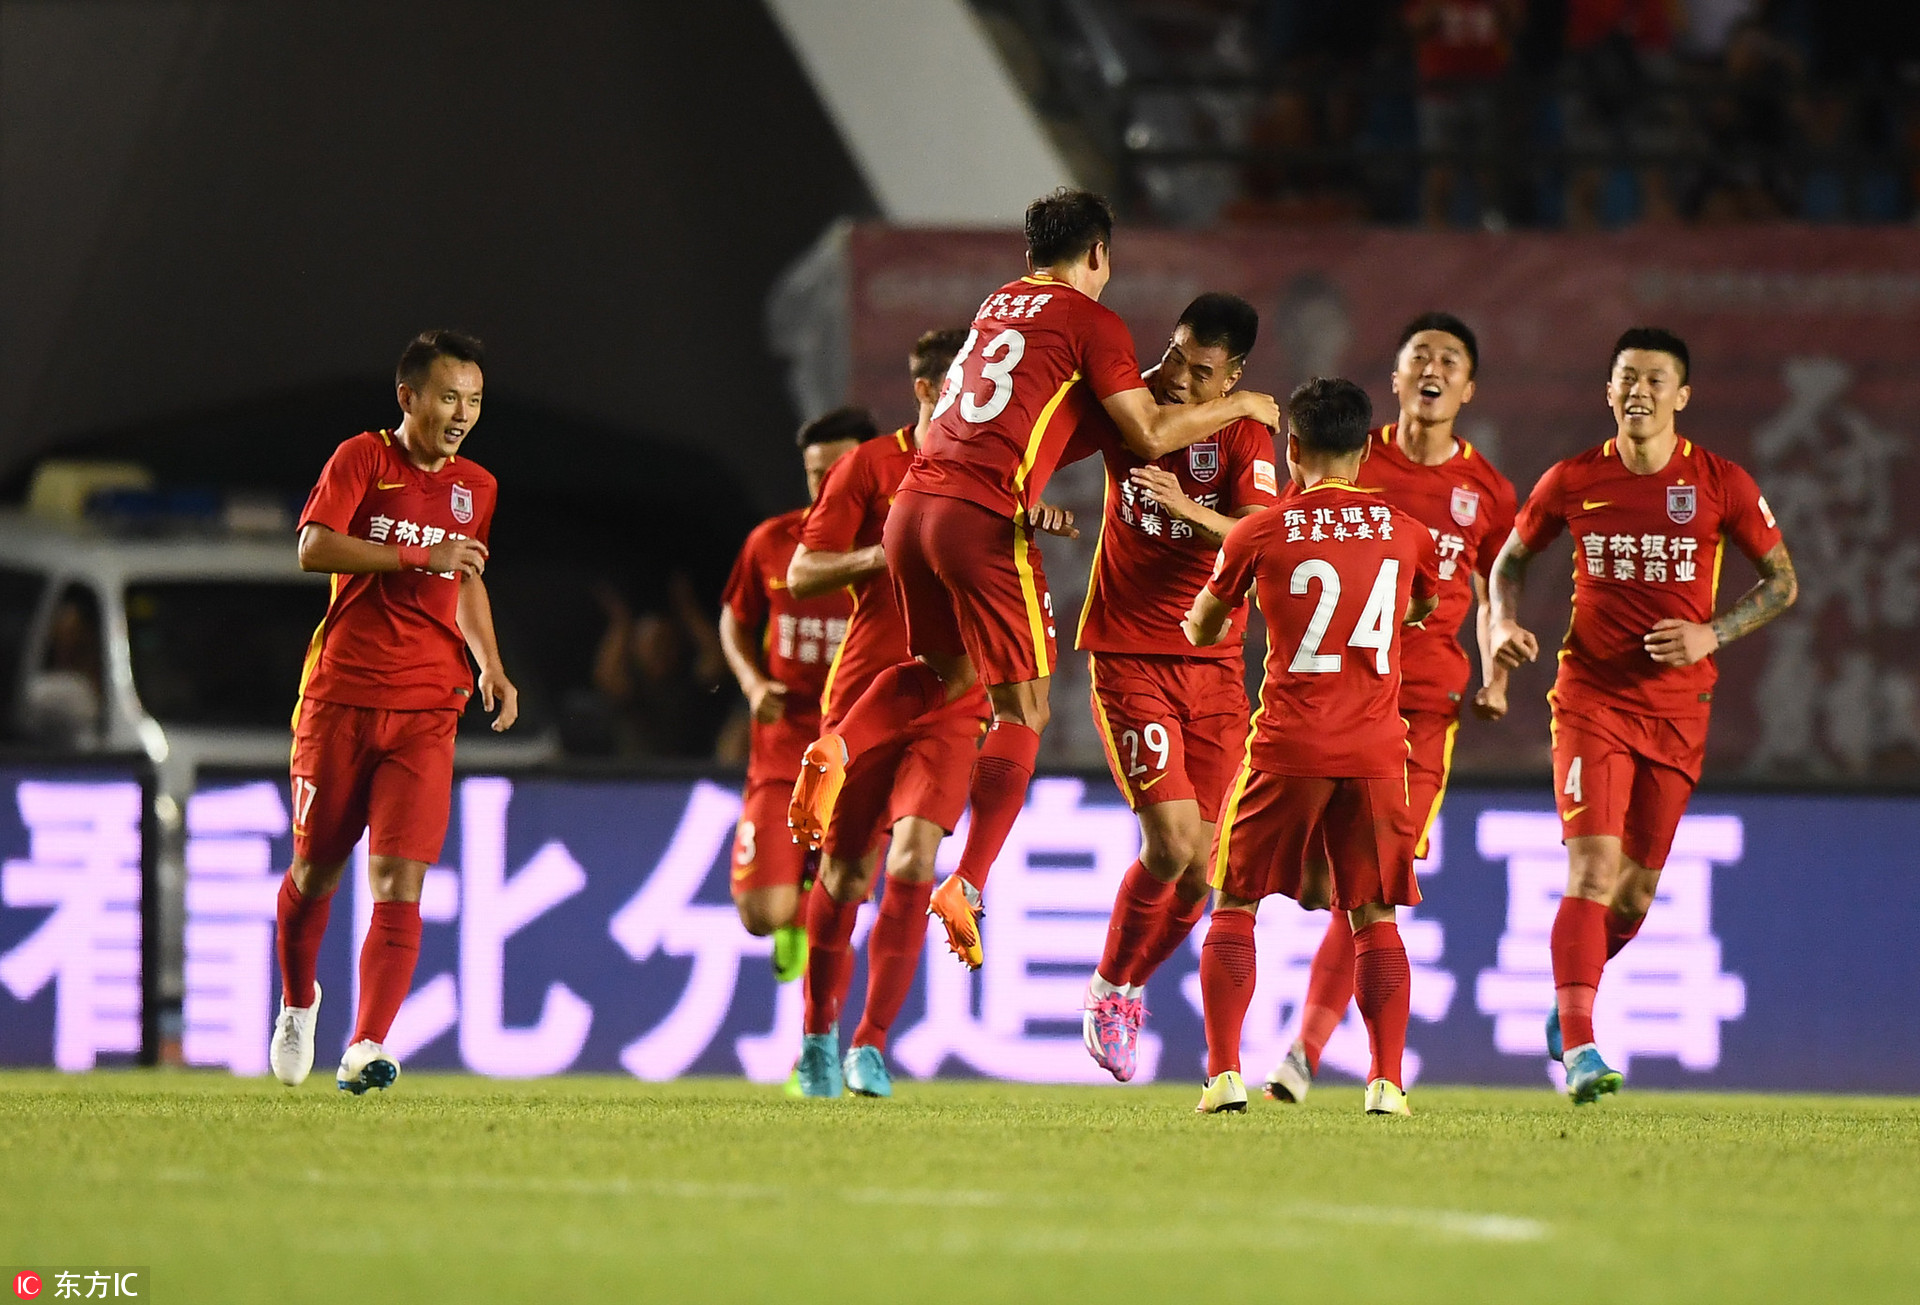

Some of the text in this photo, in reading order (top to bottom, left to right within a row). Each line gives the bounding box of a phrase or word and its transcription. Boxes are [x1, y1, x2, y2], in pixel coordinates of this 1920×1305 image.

[930, 329, 1025, 423] 33
[1120, 478, 1219, 514] 吉林行
[369, 514, 467, 548] 吉林银
[1283, 506, 1392, 527] 东北证券
[1286, 522, 1394, 543] 亚泰永安堂
[1428, 527, 1464, 560] 行
[1582, 532, 1698, 561] 吉林银行
[1586, 558, 1697, 582] 亚泰药业
[1288, 558, 1399, 675] 24
[1122, 723, 1169, 777] 29
[1563, 756, 1582, 803] 4
[295, 776, 318, 826] 17
